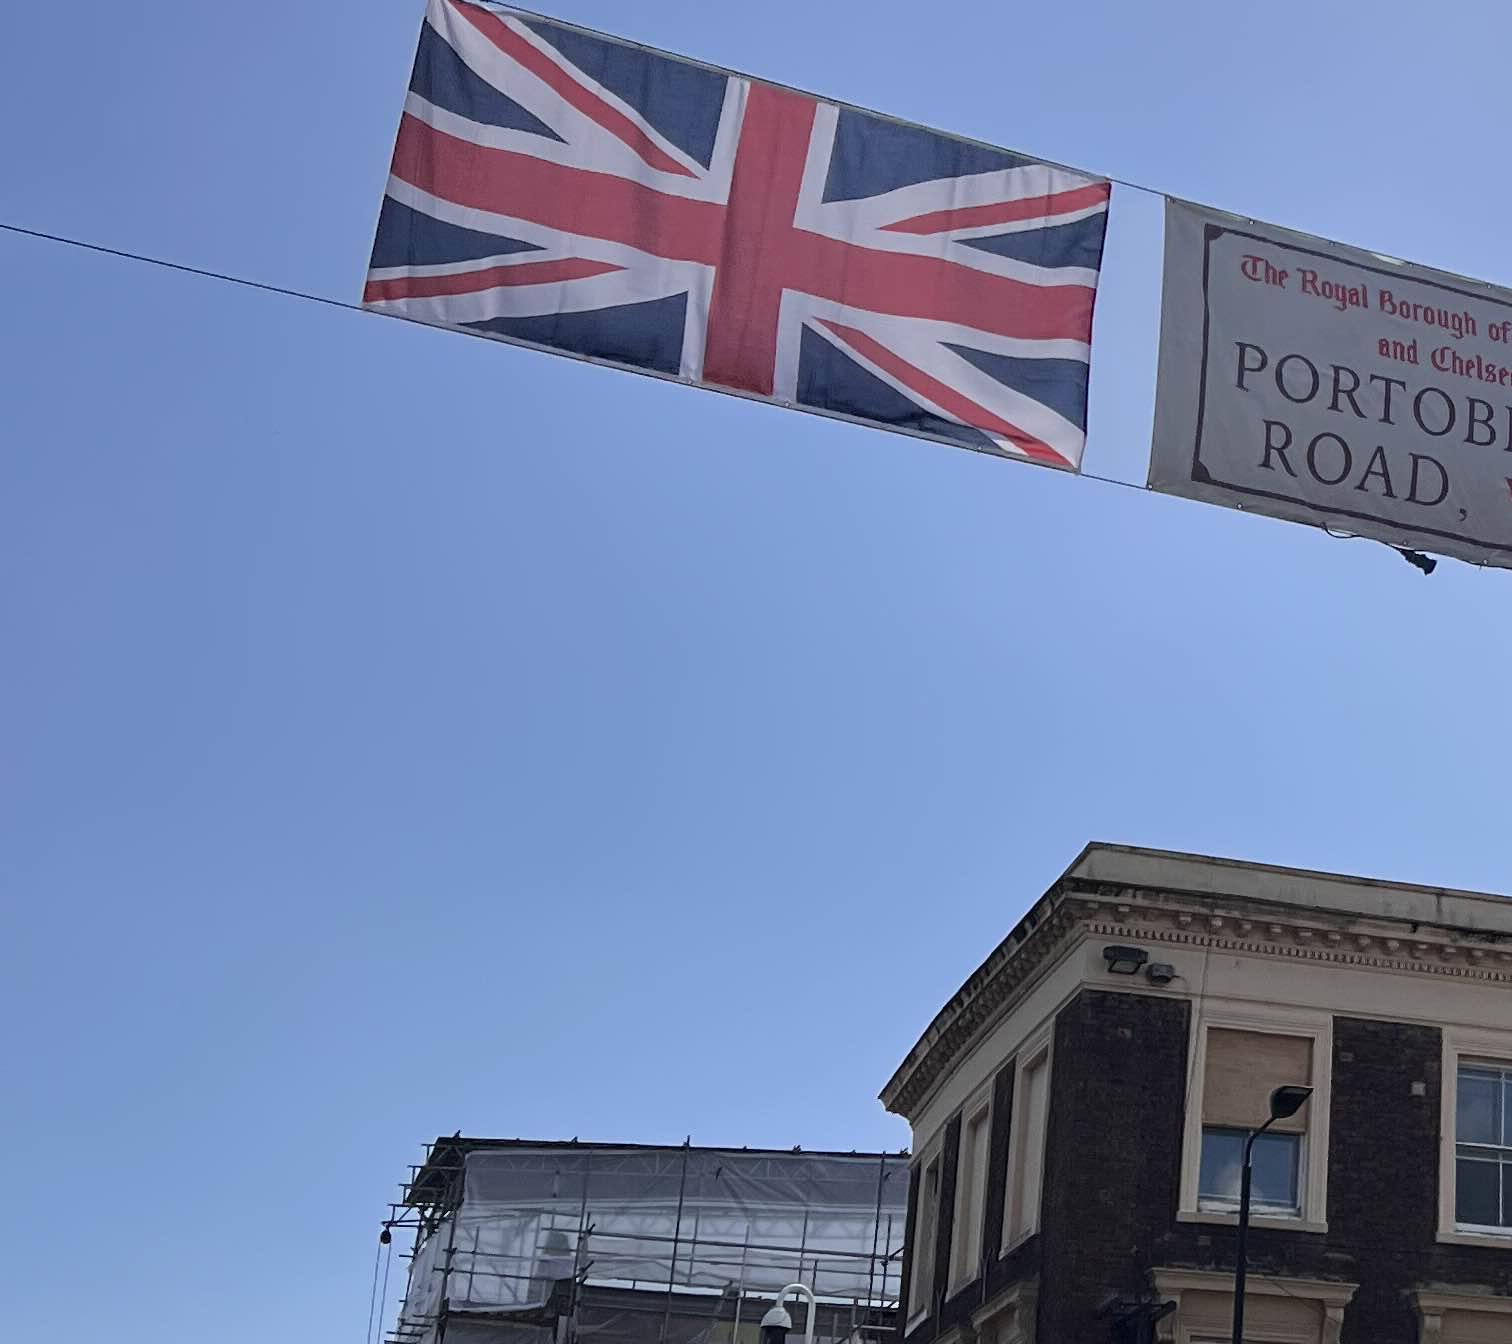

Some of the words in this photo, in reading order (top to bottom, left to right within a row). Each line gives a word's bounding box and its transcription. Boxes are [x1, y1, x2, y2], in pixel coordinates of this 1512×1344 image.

[1241, 254, 1289, 289] The
[1297, 267, 1369, 312] Royal
[1379, 288, 1477, 339] Borough
[1488, 320, 1512, 344] of
[1378, 337, 1419, 365] and
[1258, 419, 1468, 522] ROAD,
